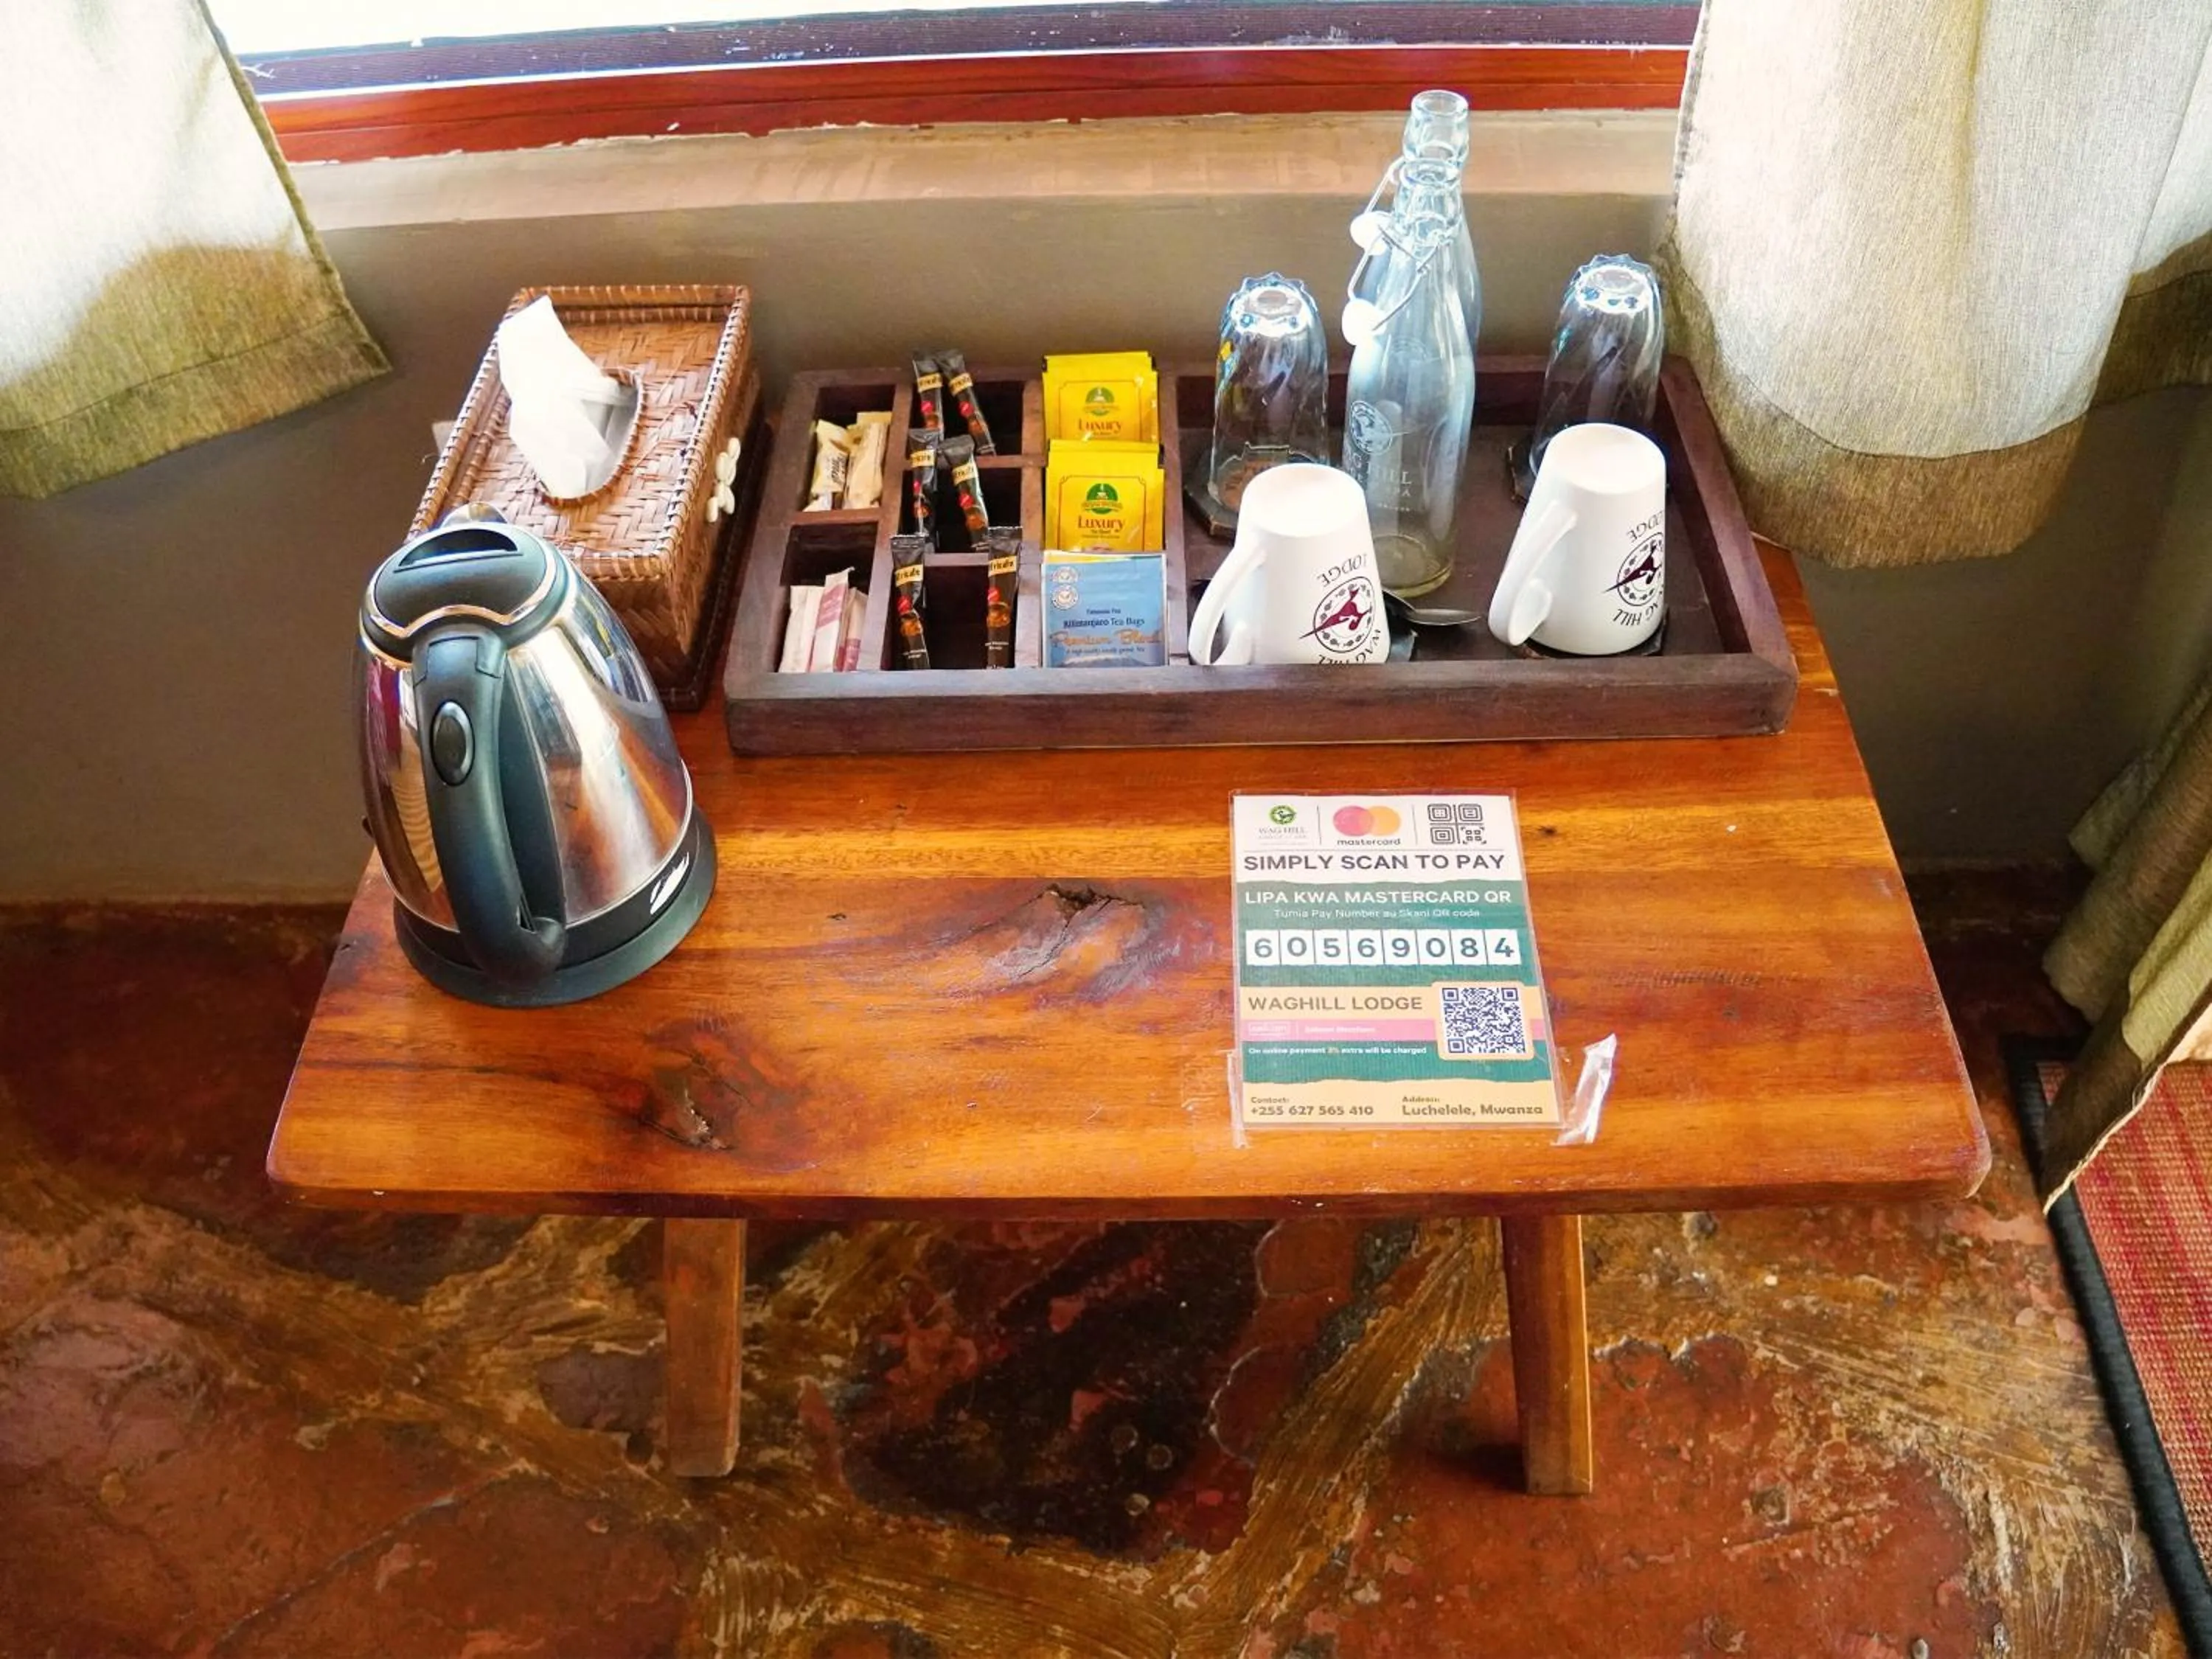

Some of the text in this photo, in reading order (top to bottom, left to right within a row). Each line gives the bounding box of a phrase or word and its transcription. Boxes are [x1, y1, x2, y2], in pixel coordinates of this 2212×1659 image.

[1078, 515, 1124, 532] Luxury
[1111, 618, 1124, 626] Tea
[1127, 617, 1145, 627] Bags
[1613, 608, 1642, 626] HILL
[1244, 855, 1505, 870] SIMPLY SCAN TO PAY
[1245, 891, 1512, 903] LIPA KWA MASTERCARD QR
[1312, 910, 1331, 919] Pay
[1335, 909, 1380, 917] Number
[1248, 996, 1422, 1010] WAGHILL LODGE
[1290, 1046, 1326, 1056] payment
[1394, 1046, 1427, 1056] charged
[1251, 1105, 1374, 1116] +255 627 565 410
[1402, 1104, 1543, 1116] Luchelele, Mwanza
